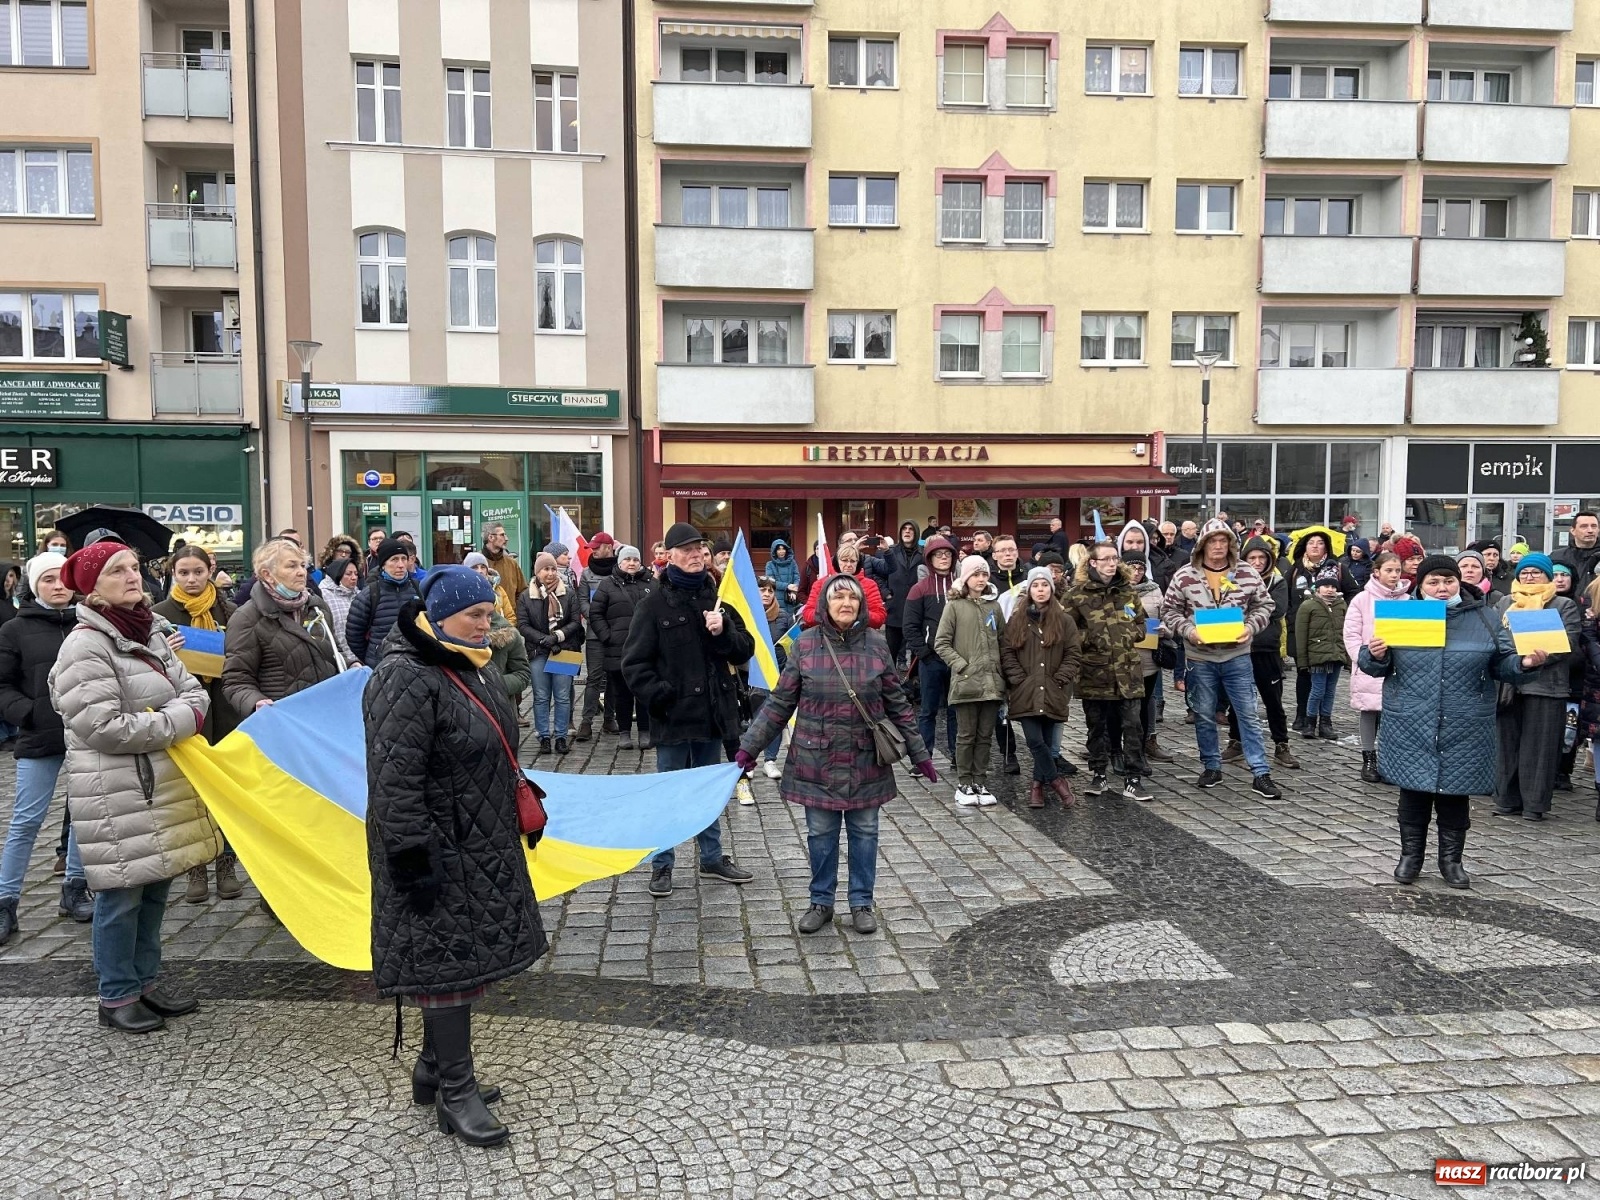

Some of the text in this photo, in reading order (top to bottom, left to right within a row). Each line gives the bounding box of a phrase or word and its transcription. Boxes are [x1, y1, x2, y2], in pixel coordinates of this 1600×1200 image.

[47, 381, 101, 389] ADWOKACKIE
[511, 394, 604, 404] STEFCZYK FINANSE
[827, 446, 990, 462] RESTAURACJA
[1480, 454, 1544, 480] empik
[148, 505, 234, 522] CASIO
[482, 506, 513, 517] GRAMY
